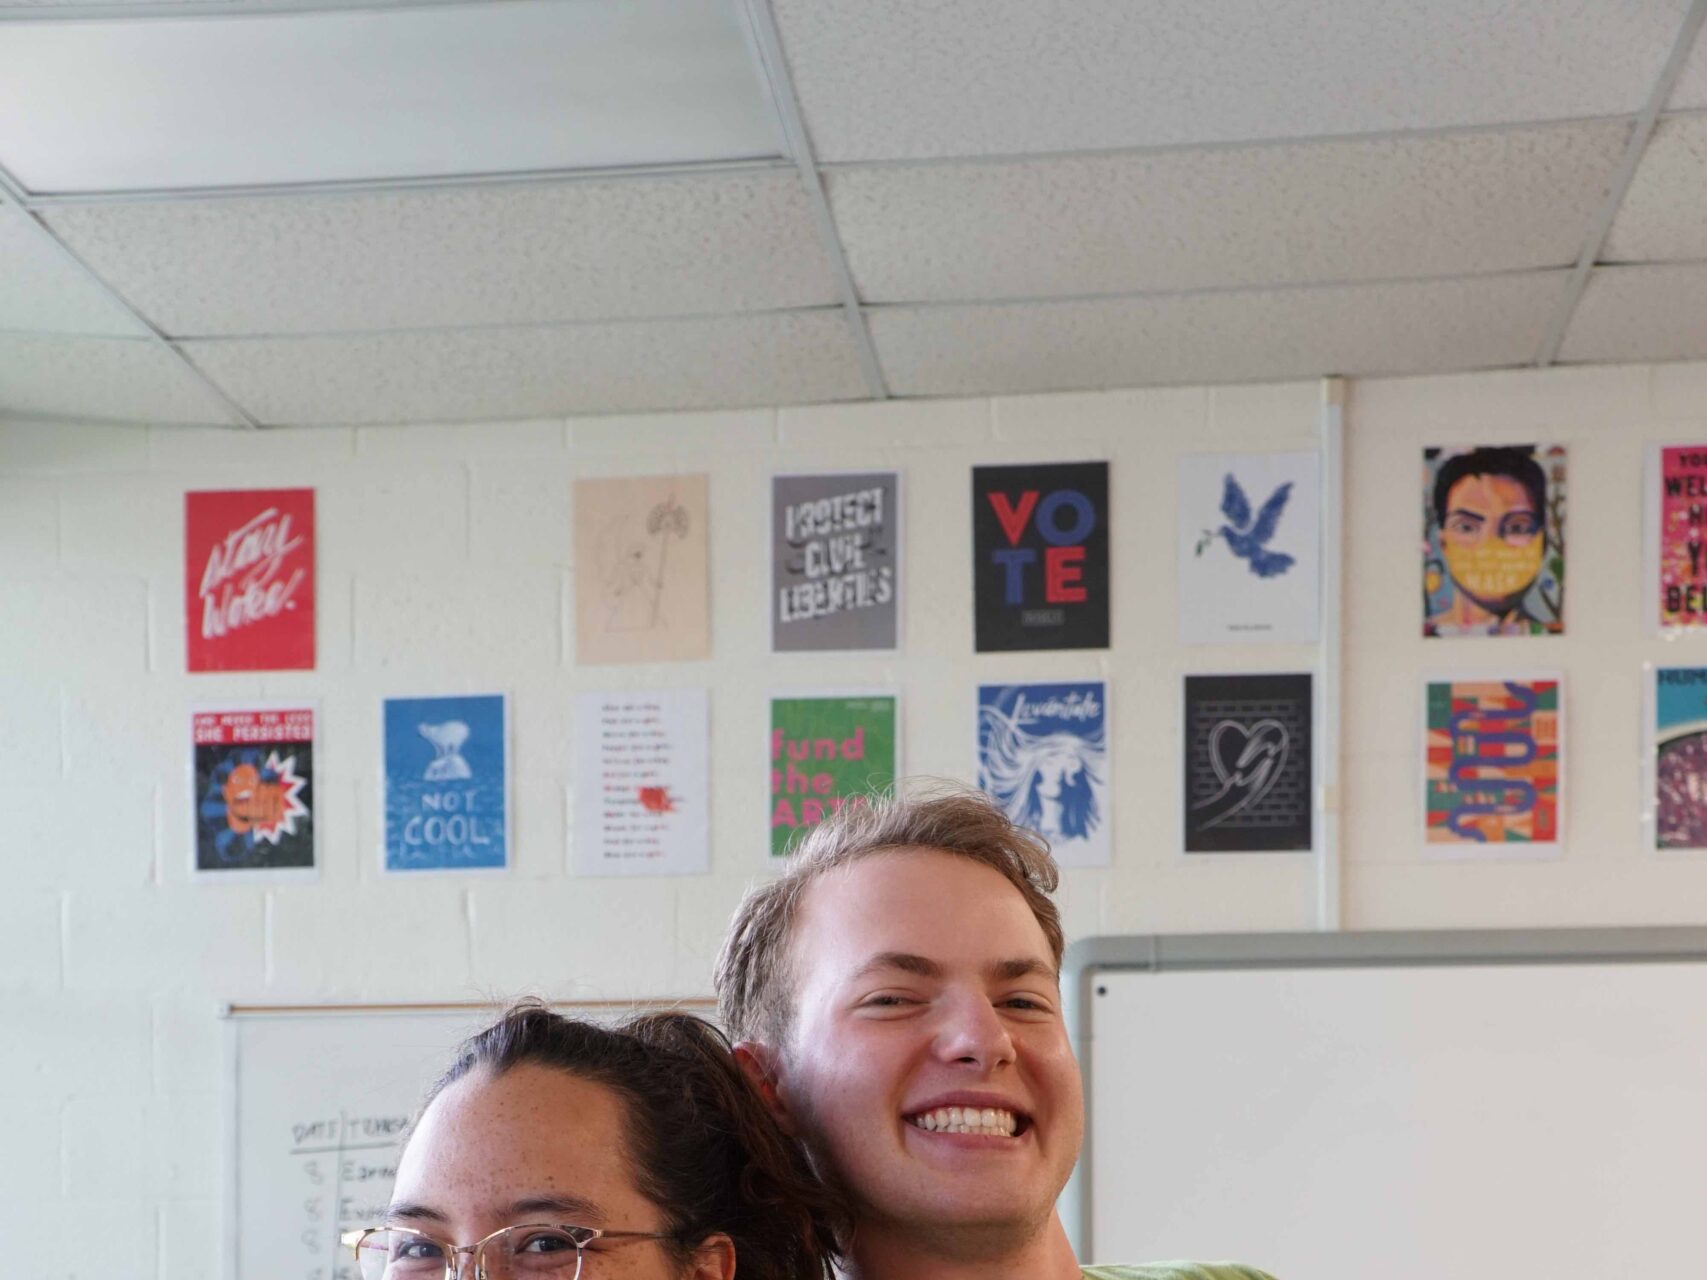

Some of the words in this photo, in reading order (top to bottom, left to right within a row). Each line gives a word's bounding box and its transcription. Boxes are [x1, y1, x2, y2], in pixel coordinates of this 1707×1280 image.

[785, 487, 883, 541] PROTECT
[772, 726, 865, 762] fund
[421, 789, 478, 812] NOT
[404, 813, 491, 846] COOL
